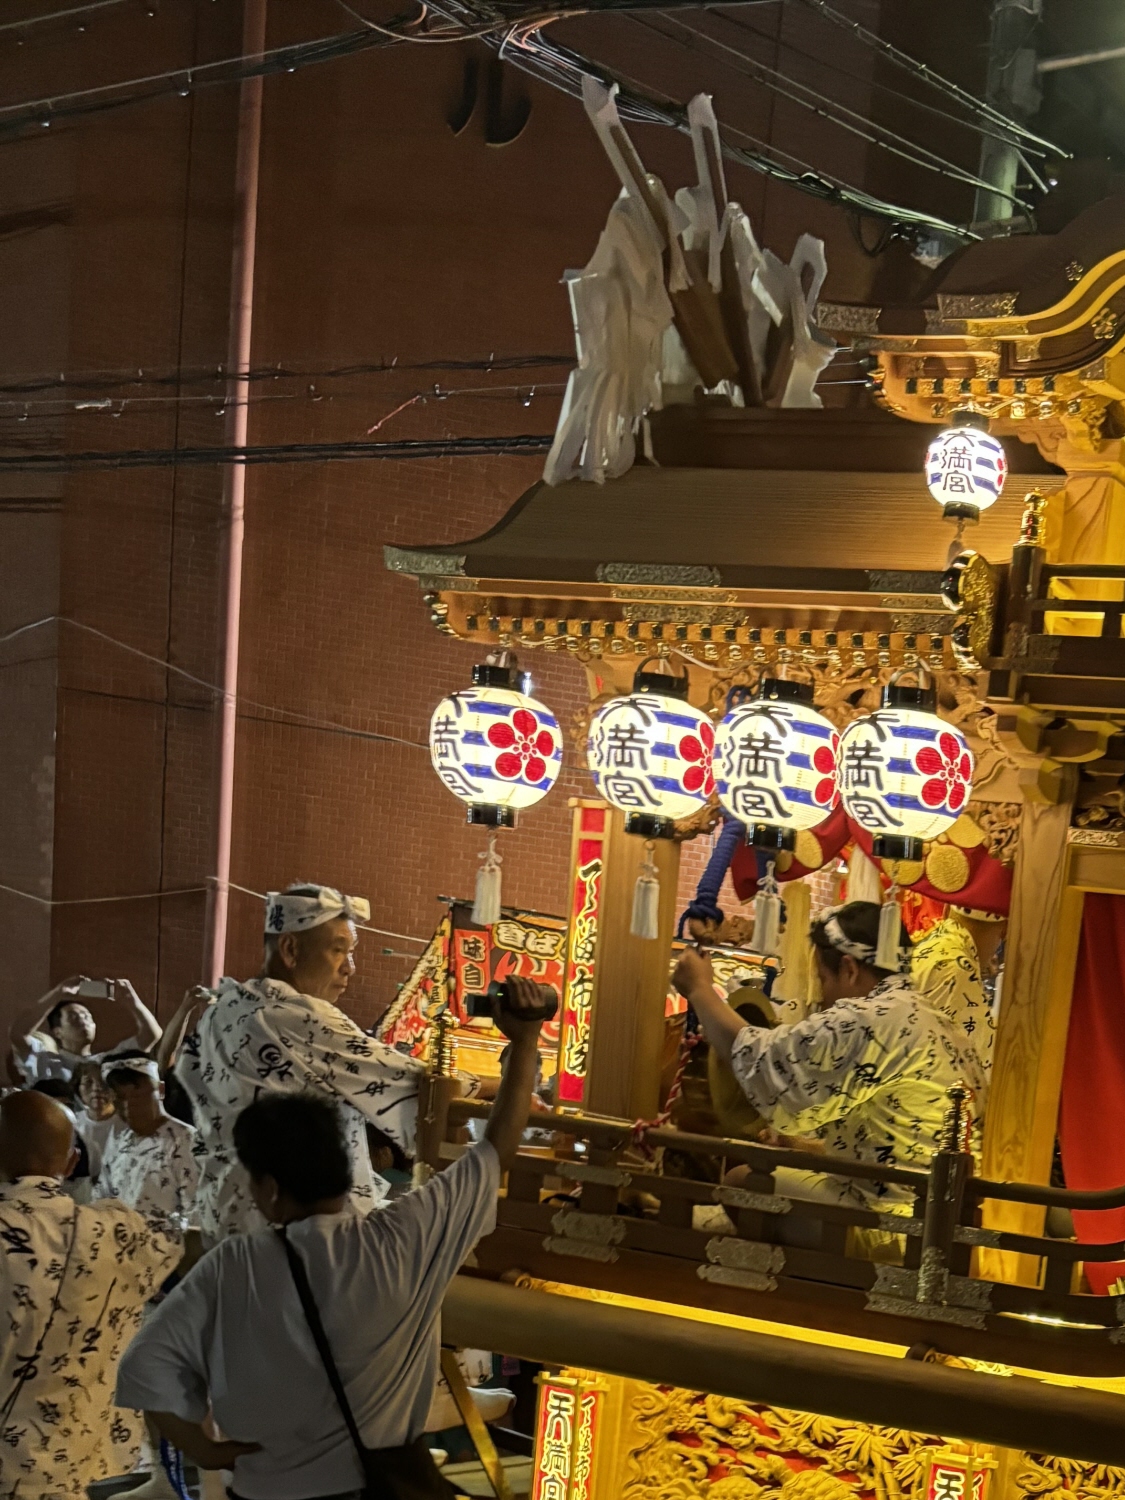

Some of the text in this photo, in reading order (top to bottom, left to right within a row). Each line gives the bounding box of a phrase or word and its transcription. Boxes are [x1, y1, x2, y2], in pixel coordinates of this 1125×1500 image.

[941, 430, 977, 494] 天満宮
[600, 697, 663, 808] 天満宮
[726, 704, 793, 818] 天満宮
[462, 937, 485, 1012] 味自
